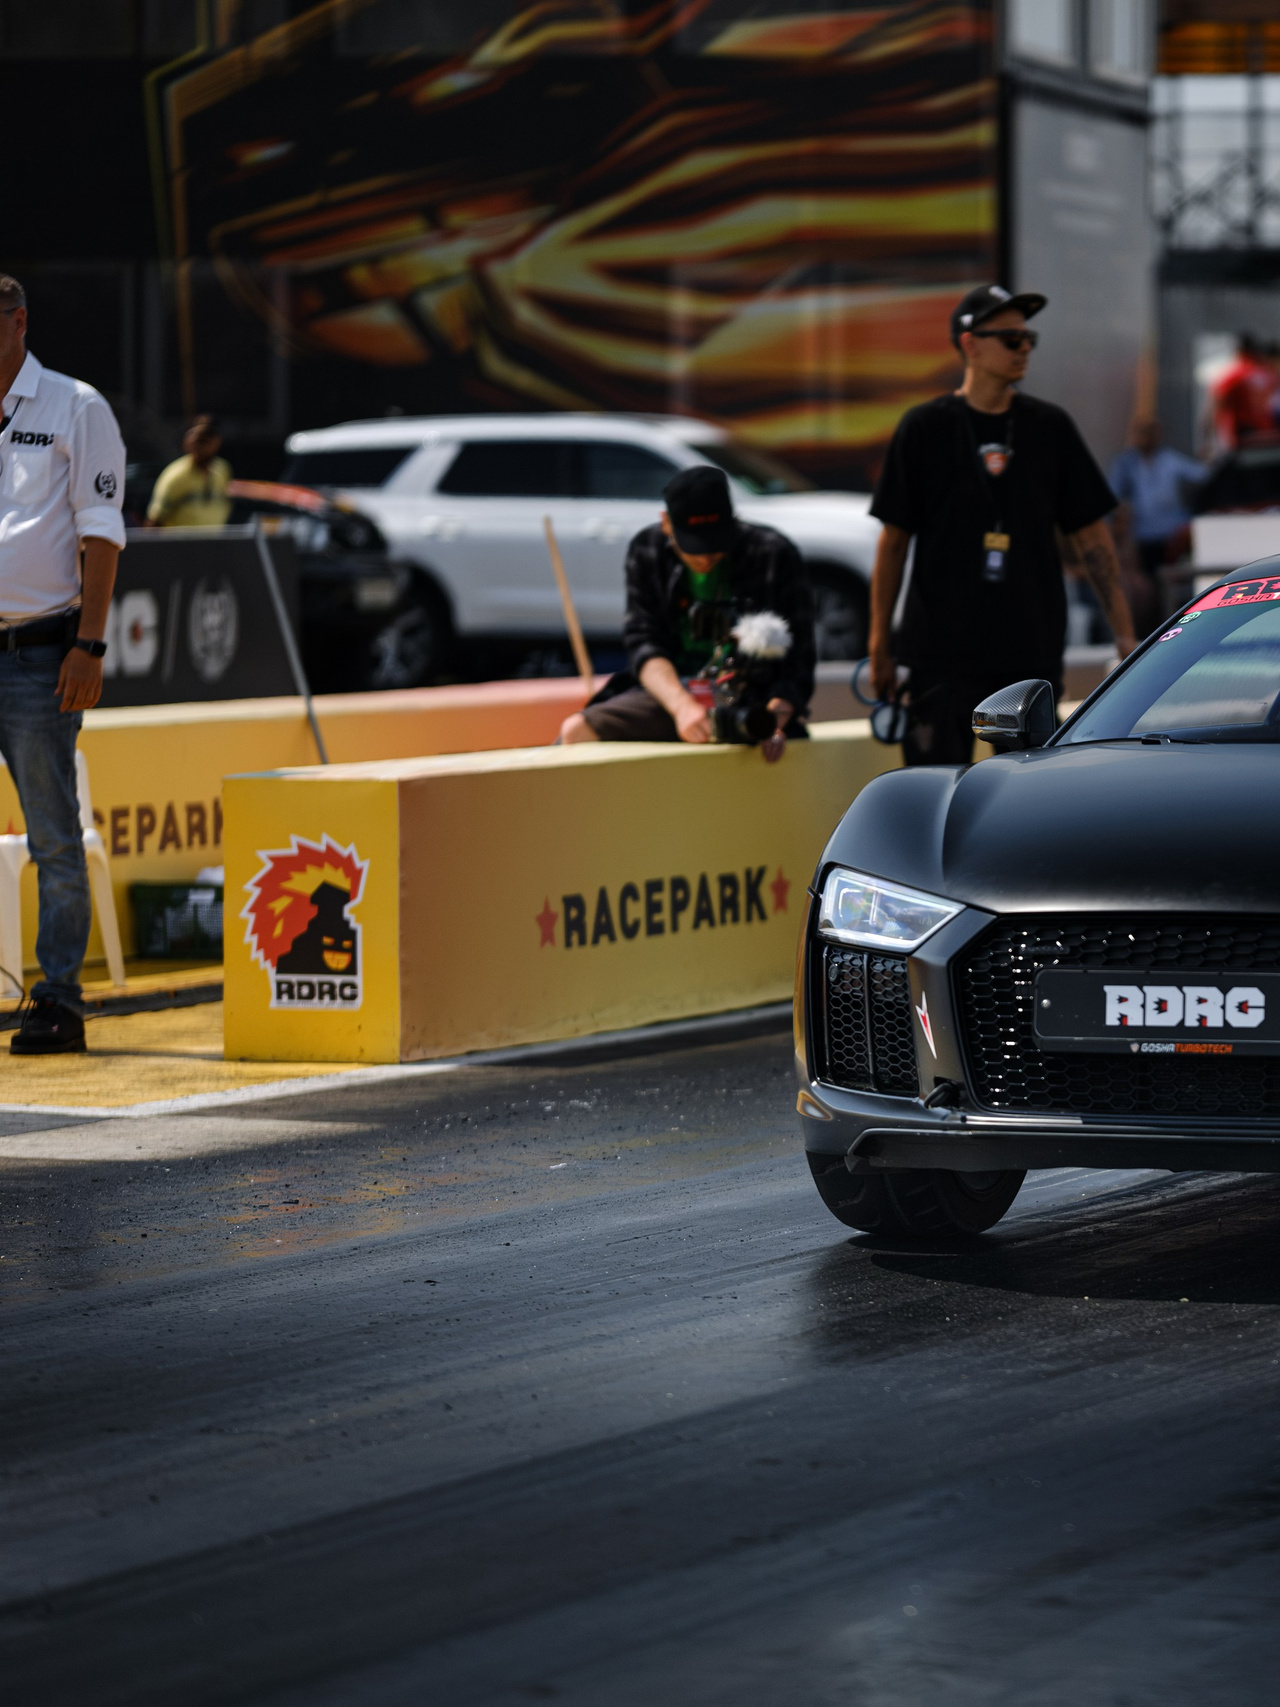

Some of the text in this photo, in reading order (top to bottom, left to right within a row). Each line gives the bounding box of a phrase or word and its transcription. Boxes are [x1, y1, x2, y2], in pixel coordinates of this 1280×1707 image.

[562, 865, 767, 948] RACEPARK
[276, 981, 358, 1001] RDRC
[1103, 985, 1266, 1028] RDRC
